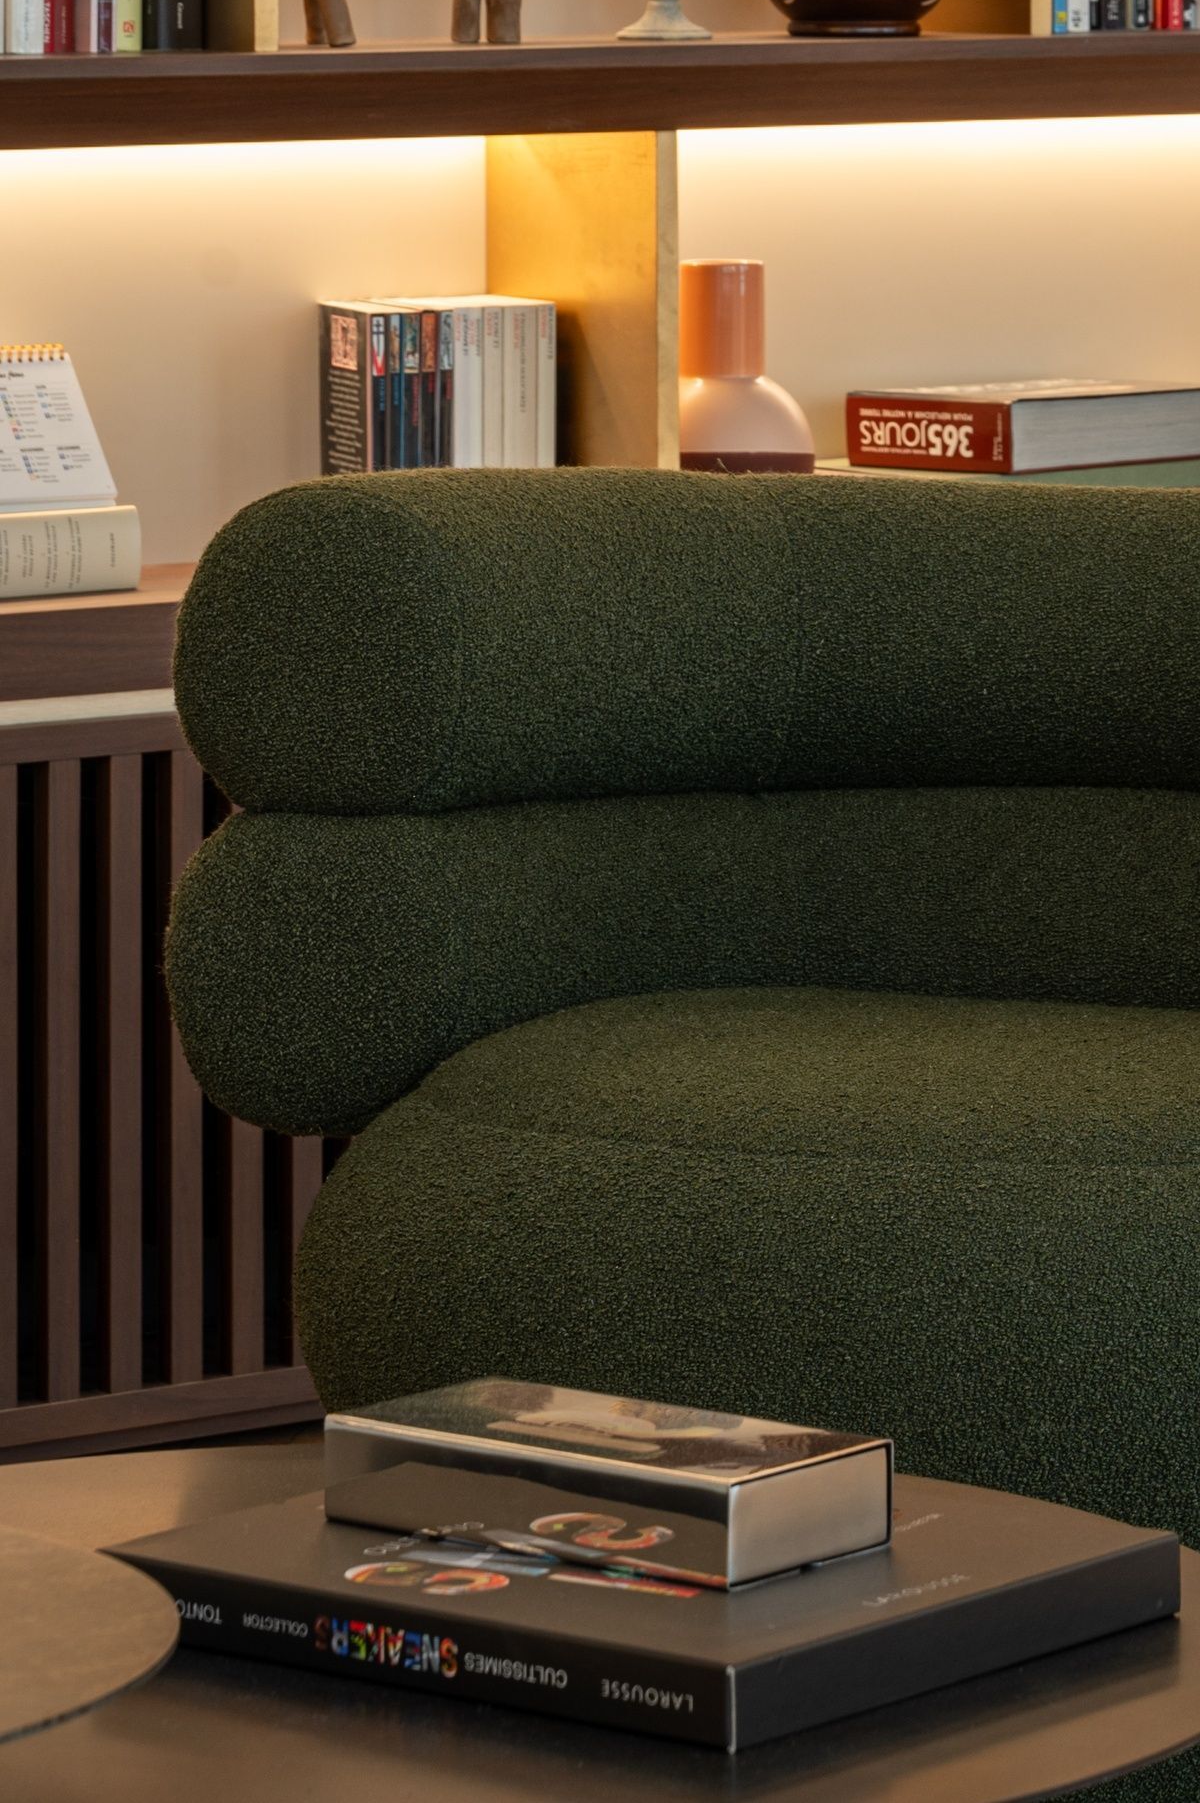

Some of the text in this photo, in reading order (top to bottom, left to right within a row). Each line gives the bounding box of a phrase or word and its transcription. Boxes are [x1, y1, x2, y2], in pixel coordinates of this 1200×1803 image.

[859, 420, 928, 447] JOURS
[928, 424, 974, 458] 365
[176, 1598, 695, 1716] LAROUSSE CULTISSIMES SNEAKERS COLLECTOR TONTO
